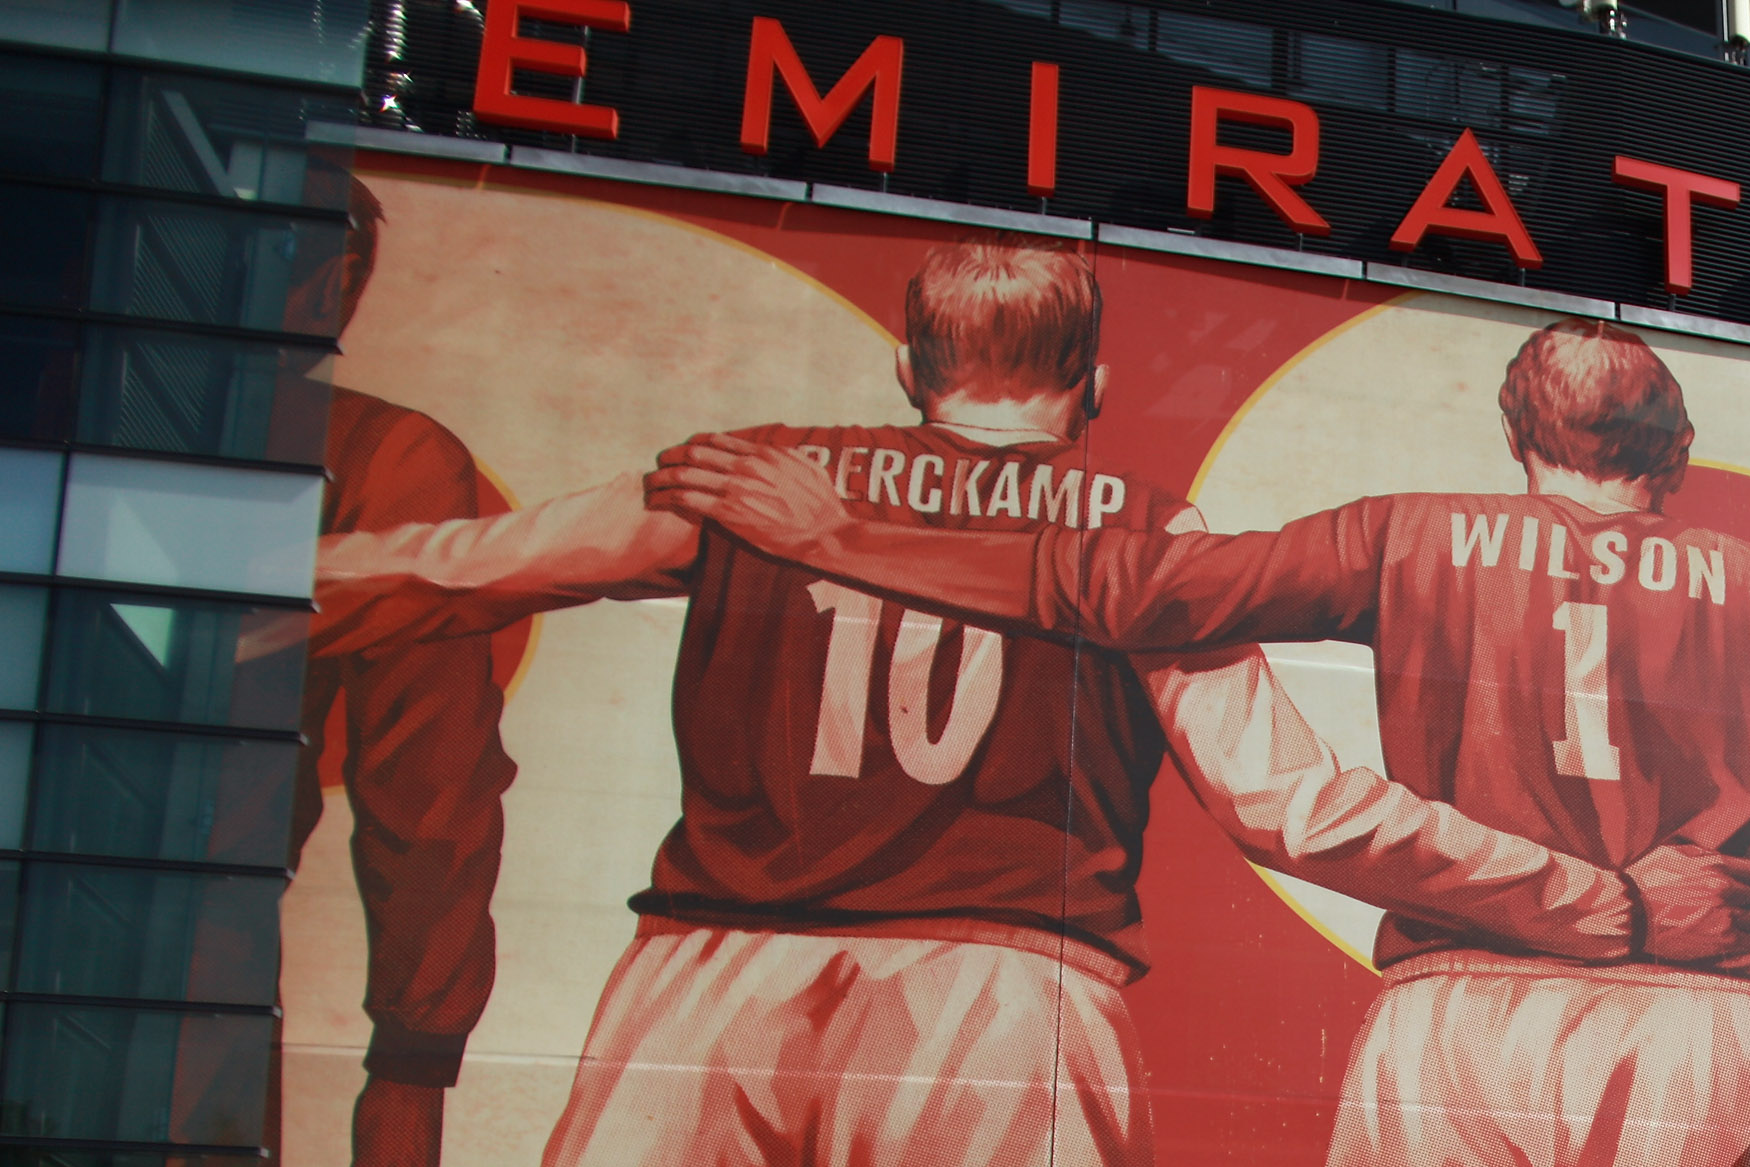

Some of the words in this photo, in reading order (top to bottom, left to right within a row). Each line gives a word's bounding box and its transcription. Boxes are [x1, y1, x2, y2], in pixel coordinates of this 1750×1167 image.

[1450, 512, 1727, 606] WILSON
[806, 579, 1003, 785] 10
[1552, 600, 1621, 781] 1
